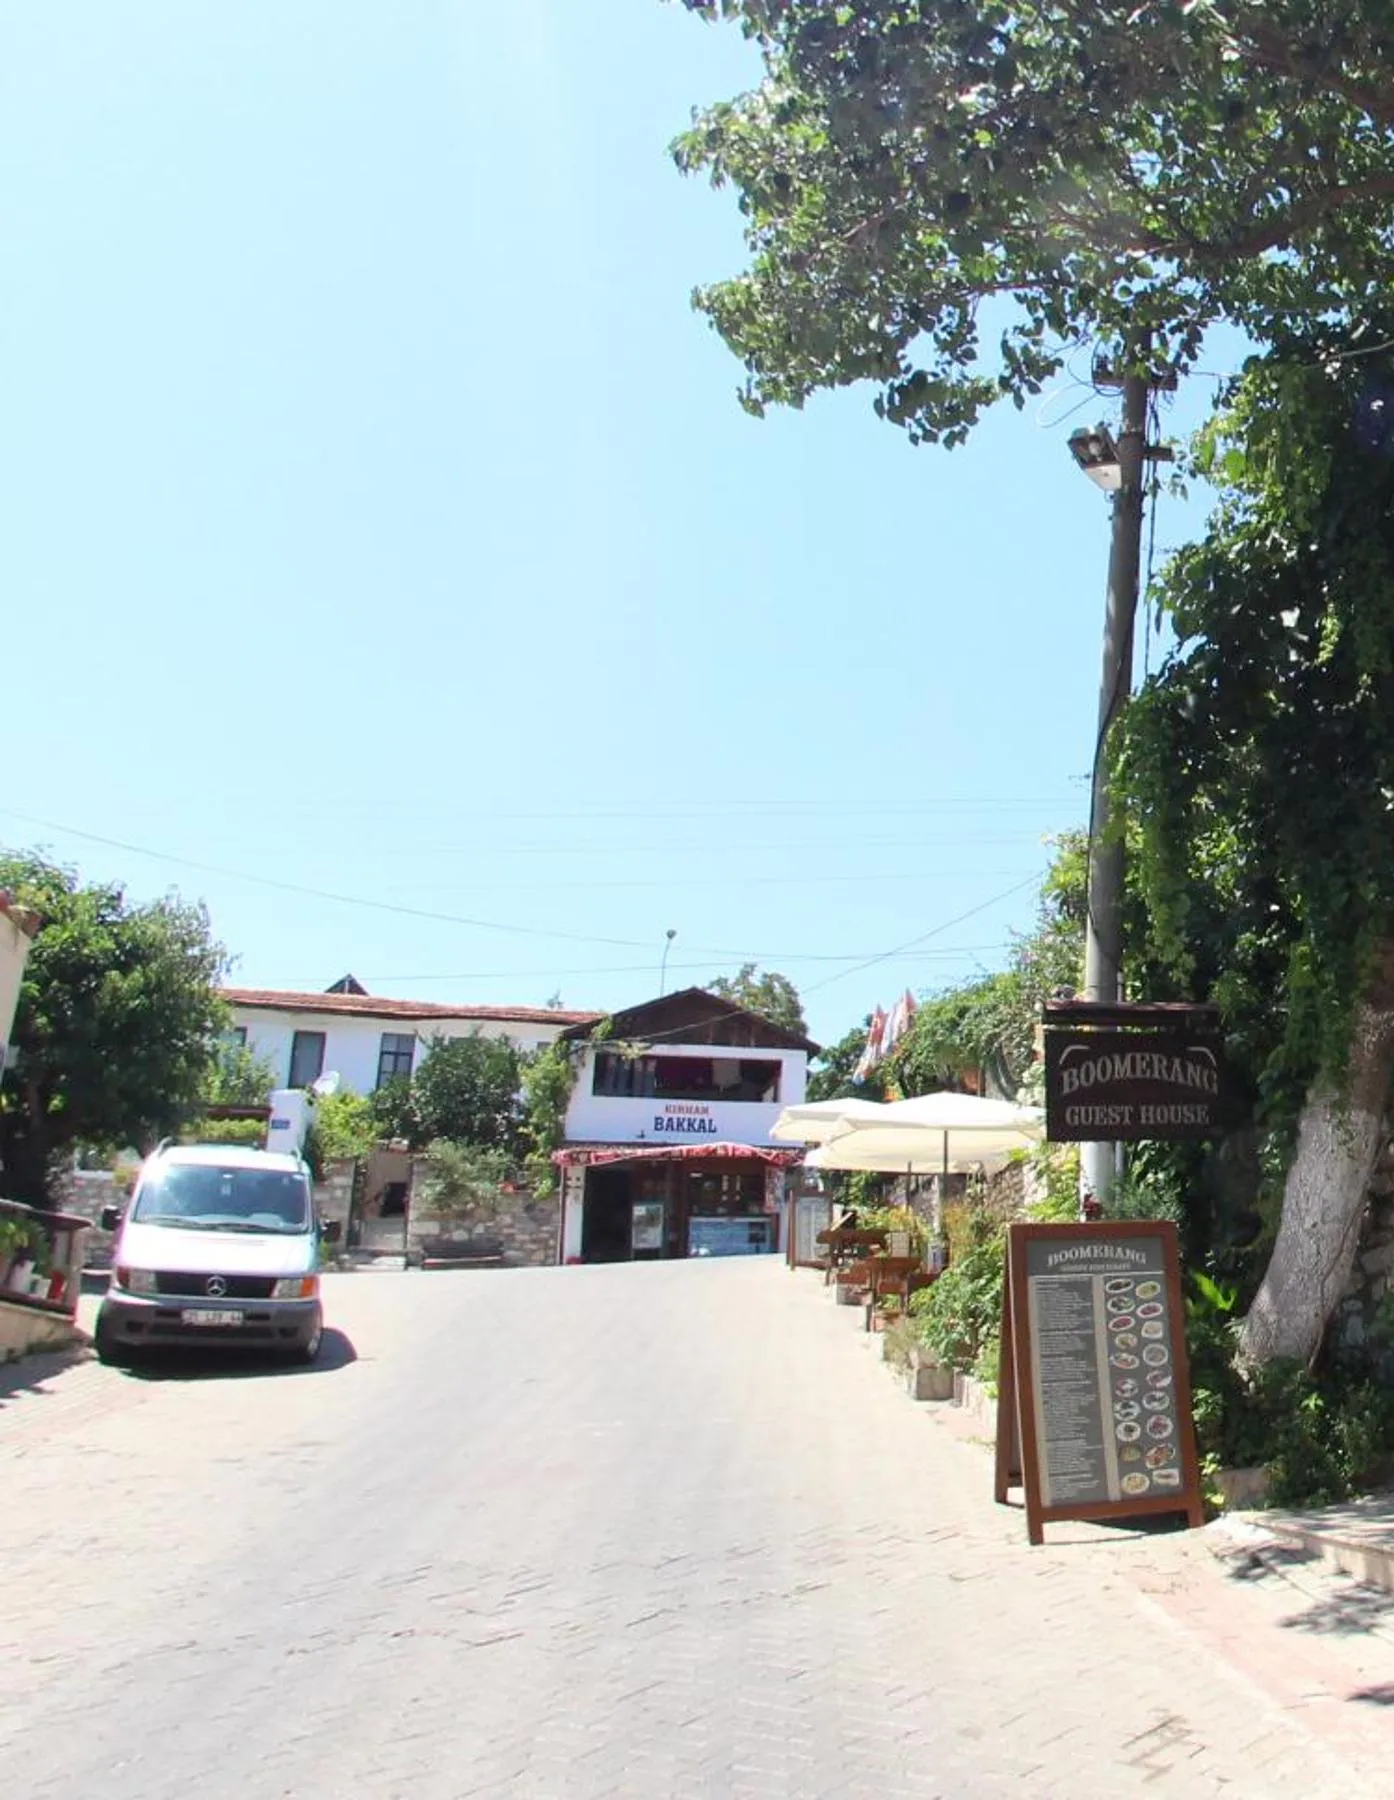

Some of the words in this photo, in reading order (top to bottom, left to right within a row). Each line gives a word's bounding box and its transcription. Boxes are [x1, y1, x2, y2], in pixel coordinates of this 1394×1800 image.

[1062, 1052, 1219, 1096] BOOMERANG
[653, 1115, 717, 1134] BAKKAL
[1065, 1104, 1134, 1127] GUEST
[1139, 1104, 1210, 1125] HOUSE
[1047, 1244, 1147, 1267] BOOMERANG
